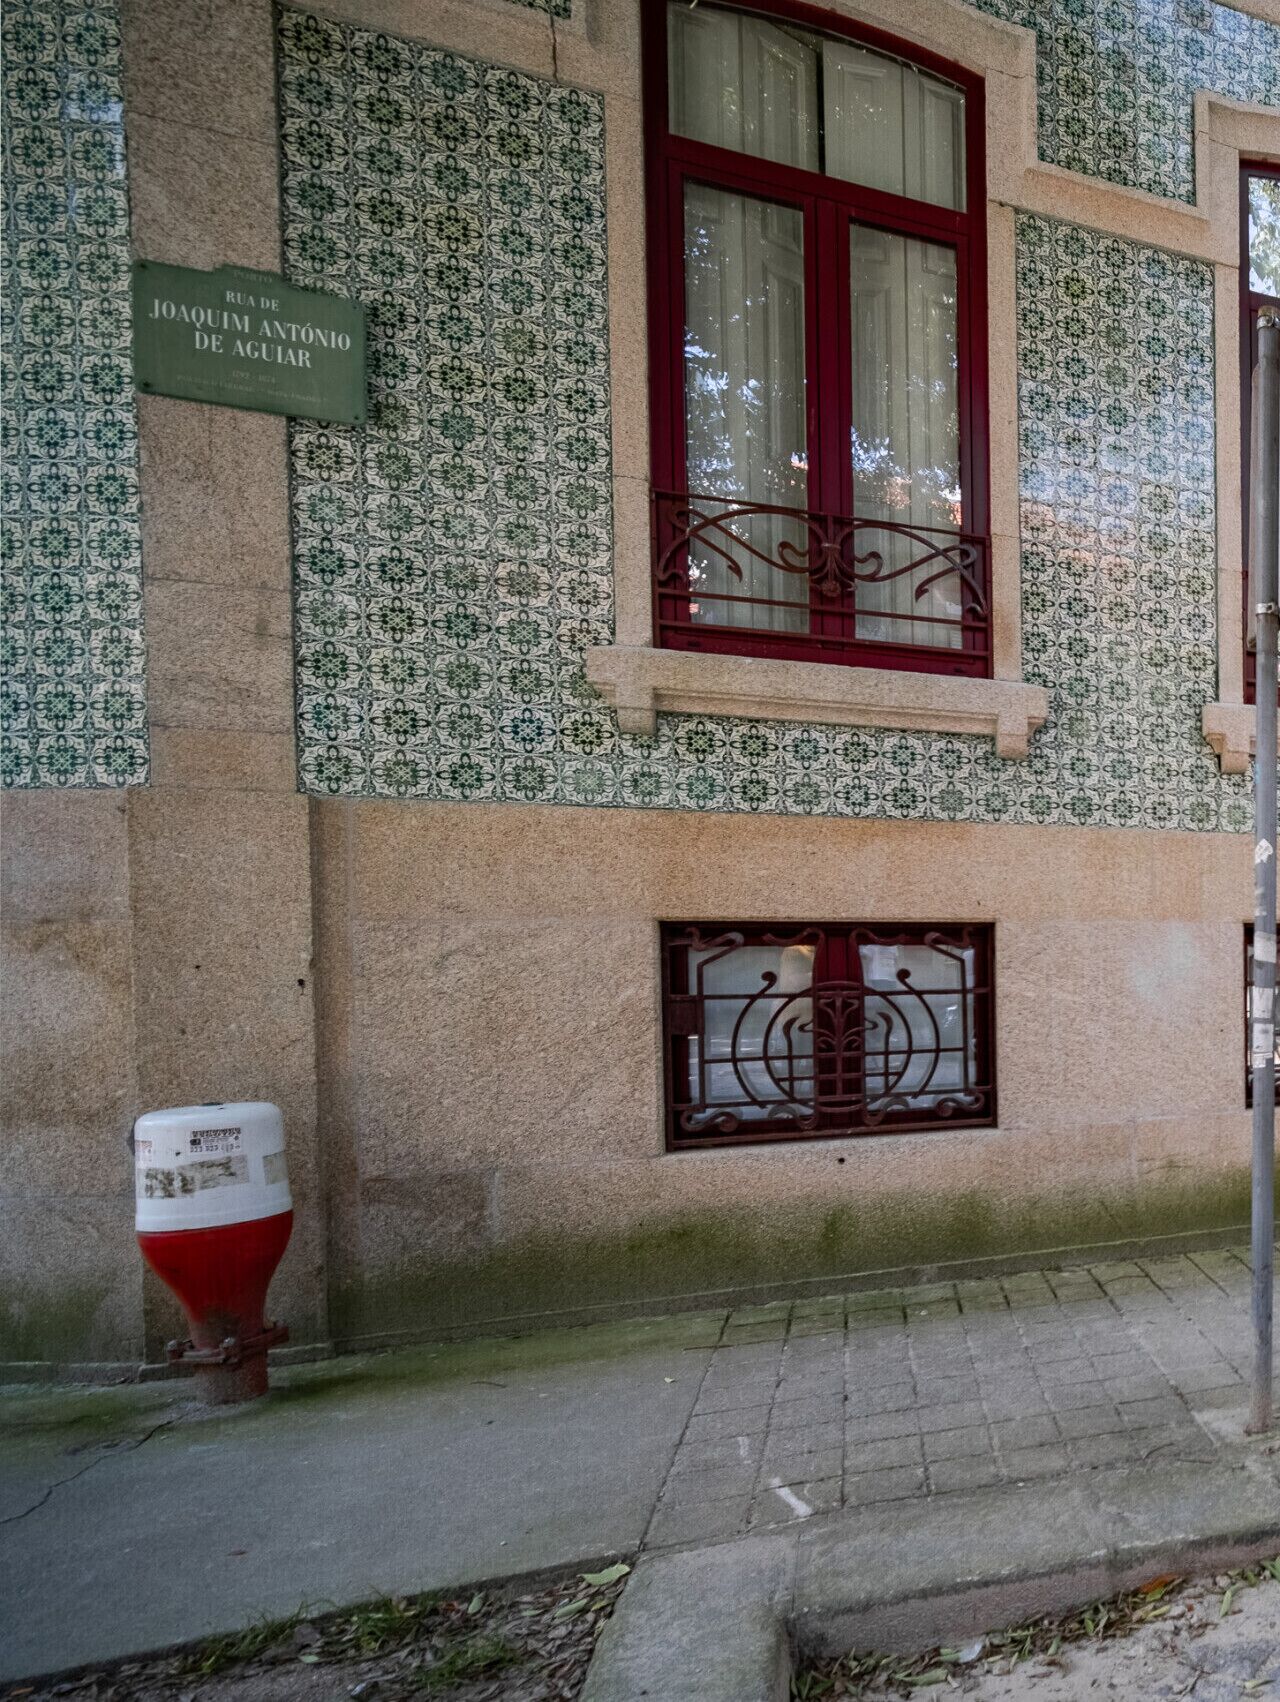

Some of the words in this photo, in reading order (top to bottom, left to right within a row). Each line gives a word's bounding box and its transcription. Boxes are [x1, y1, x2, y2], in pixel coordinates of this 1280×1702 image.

[226, 290, 255, 307] RUA
[260, 297, 281, 312] DE
[149, 299, 250, 334] JOAQUIM
[258, 320, 351, 351] ANTÓNIO
[195, 331, 224, 353] DE
[232, 339, 312, 369] AGUIAR
